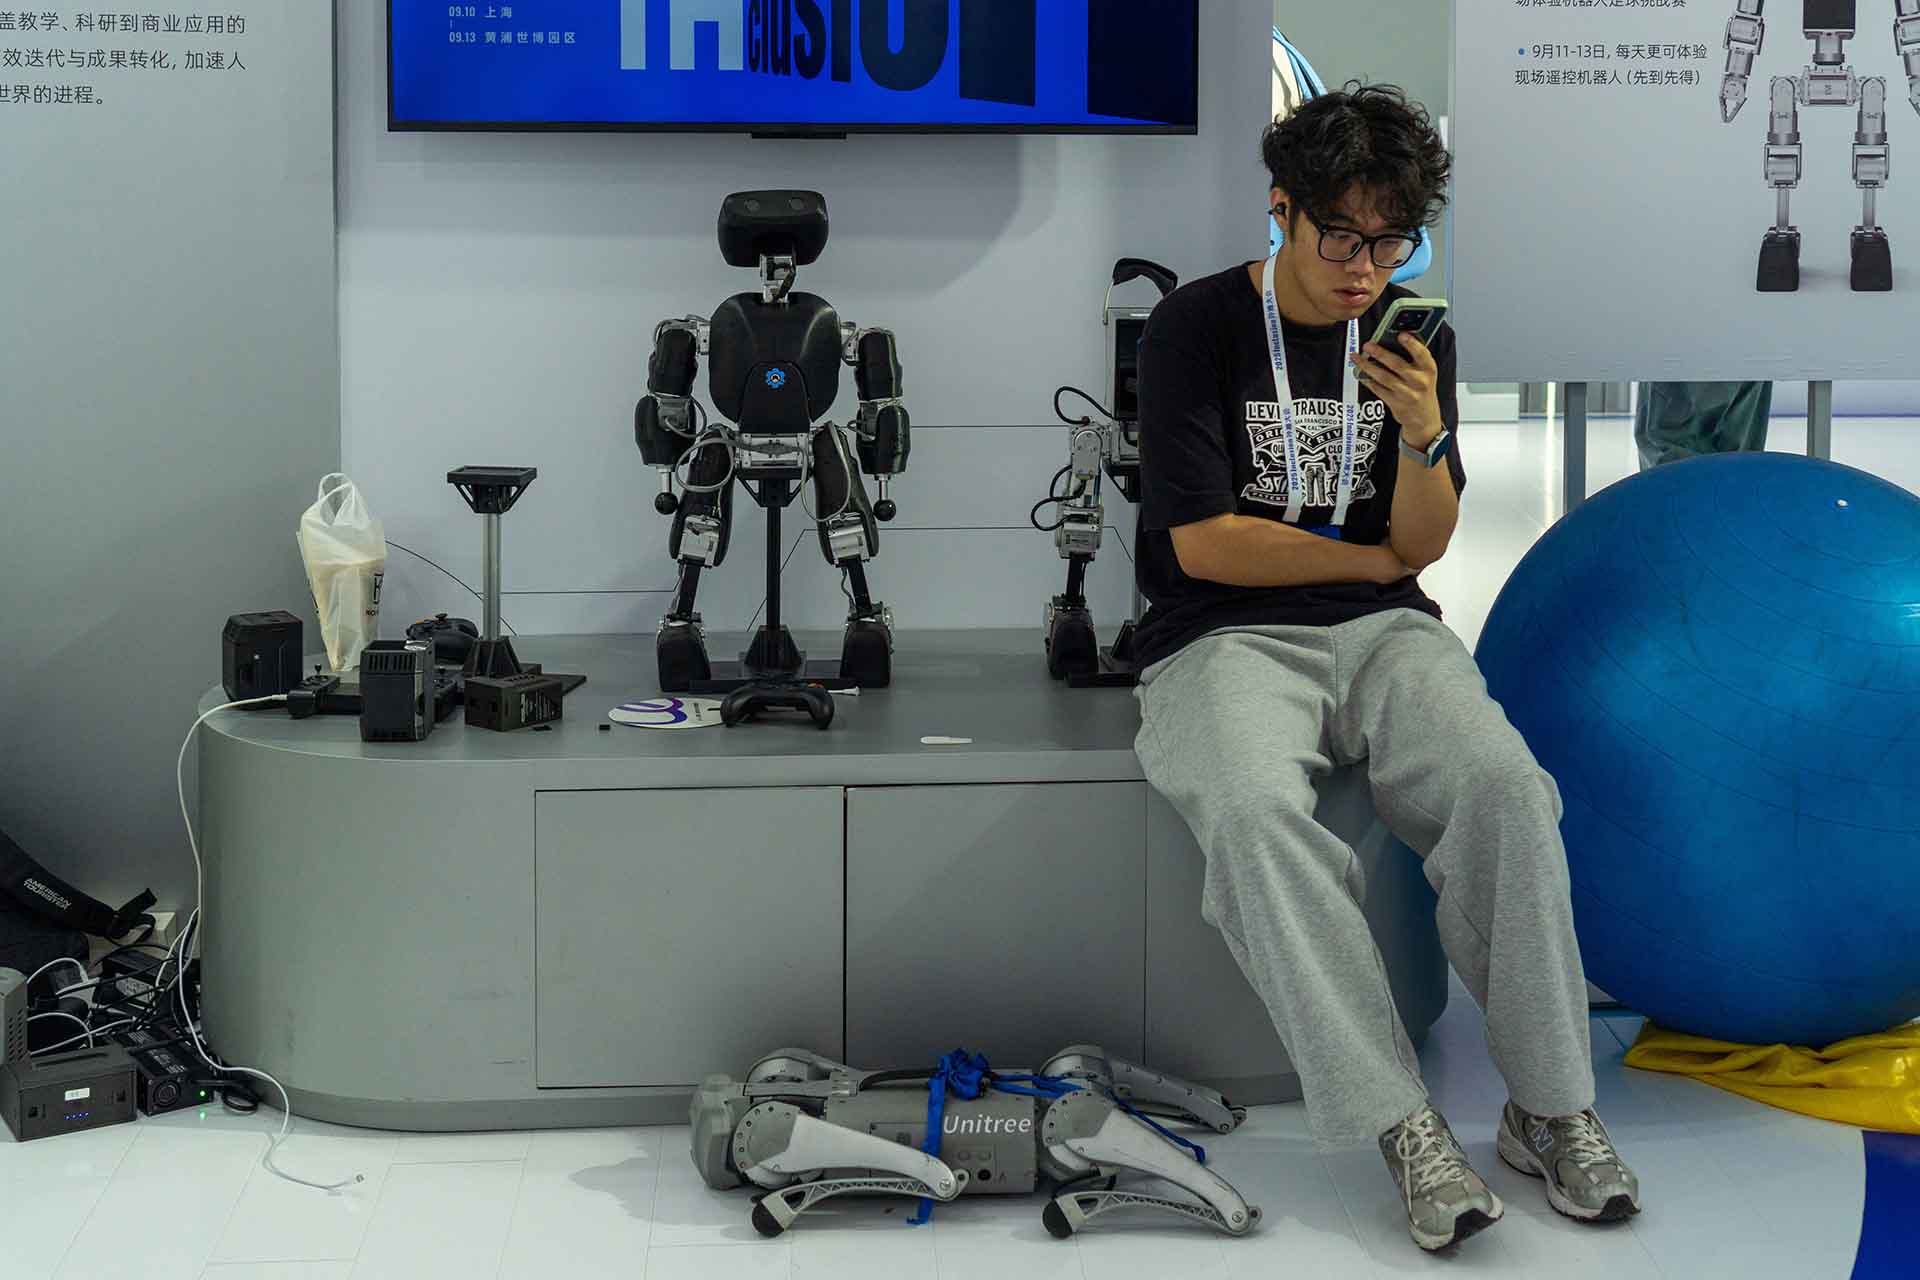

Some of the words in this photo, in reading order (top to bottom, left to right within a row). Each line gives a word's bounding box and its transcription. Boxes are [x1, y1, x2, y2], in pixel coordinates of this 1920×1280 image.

[449, 6, 476, 17] 09.10
[484, 5, 512, 19] 上海
[0, 12, 246, 34] 盖教学、科研到商业应用的
[449, 31, 476, 43] 09.13
[1293, 400, 1343, 418] TRAUSS
[25, 878, 72, 905] AMERICAN
[943, 1113, 1032, 1134] Unitree
